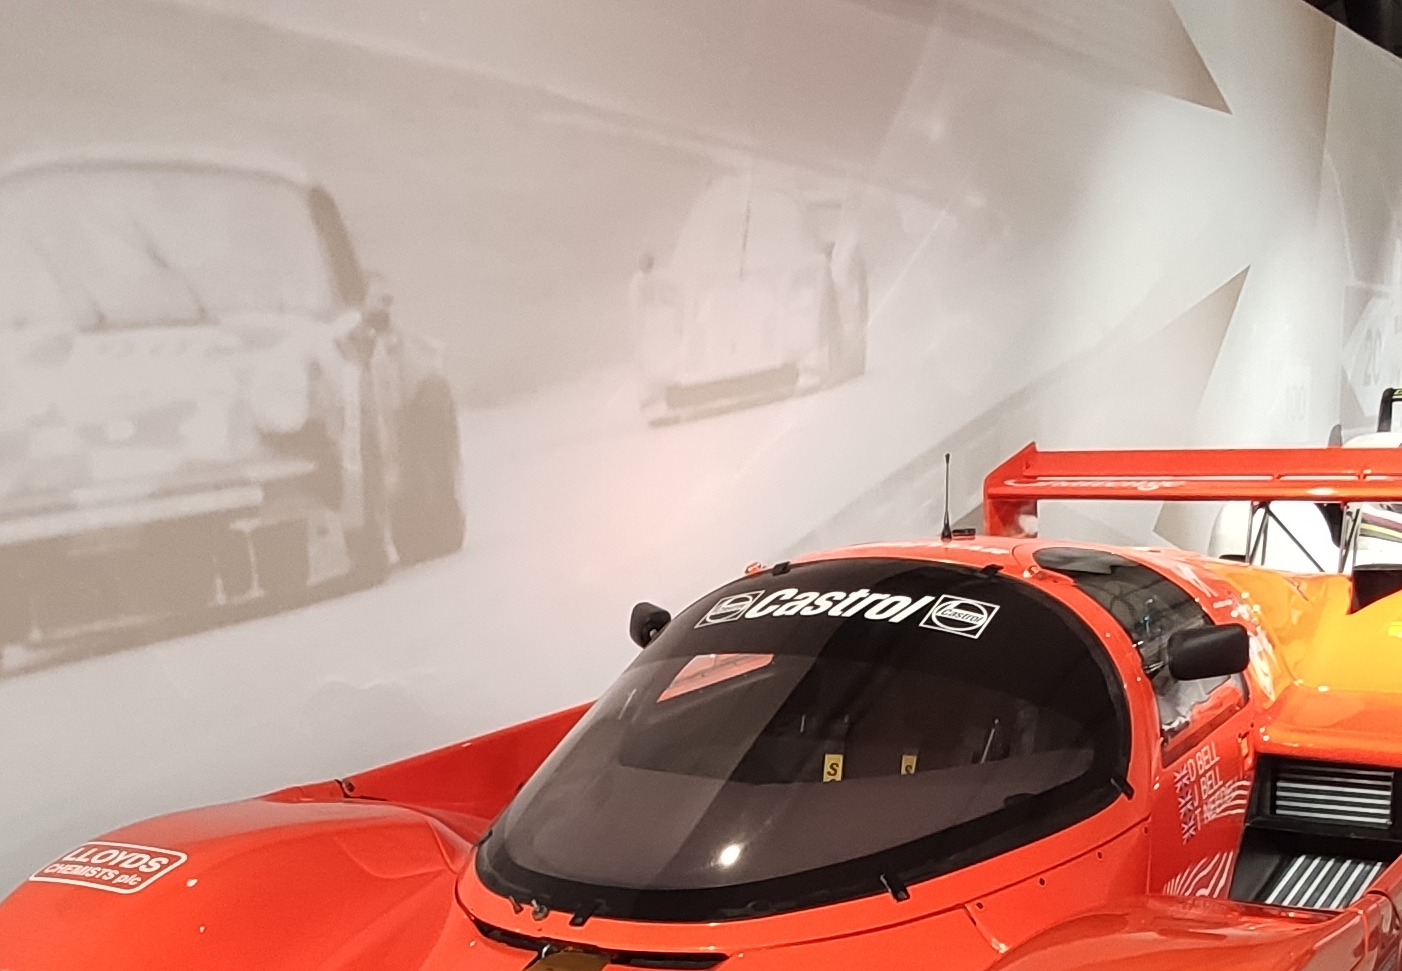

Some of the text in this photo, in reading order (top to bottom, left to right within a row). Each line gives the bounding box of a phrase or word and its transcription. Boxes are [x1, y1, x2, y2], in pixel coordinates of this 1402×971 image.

[745, 588, 935, 624] Castrol
[941, 607, 984, 623] Castrol
[1187, 741, 1221, 782] D BELL
[1200, 765, 1224, 800] BELL
[43, 863, 142, 886] CHEMISTS plc
[63, 847, 170, 873] LLOYDS
